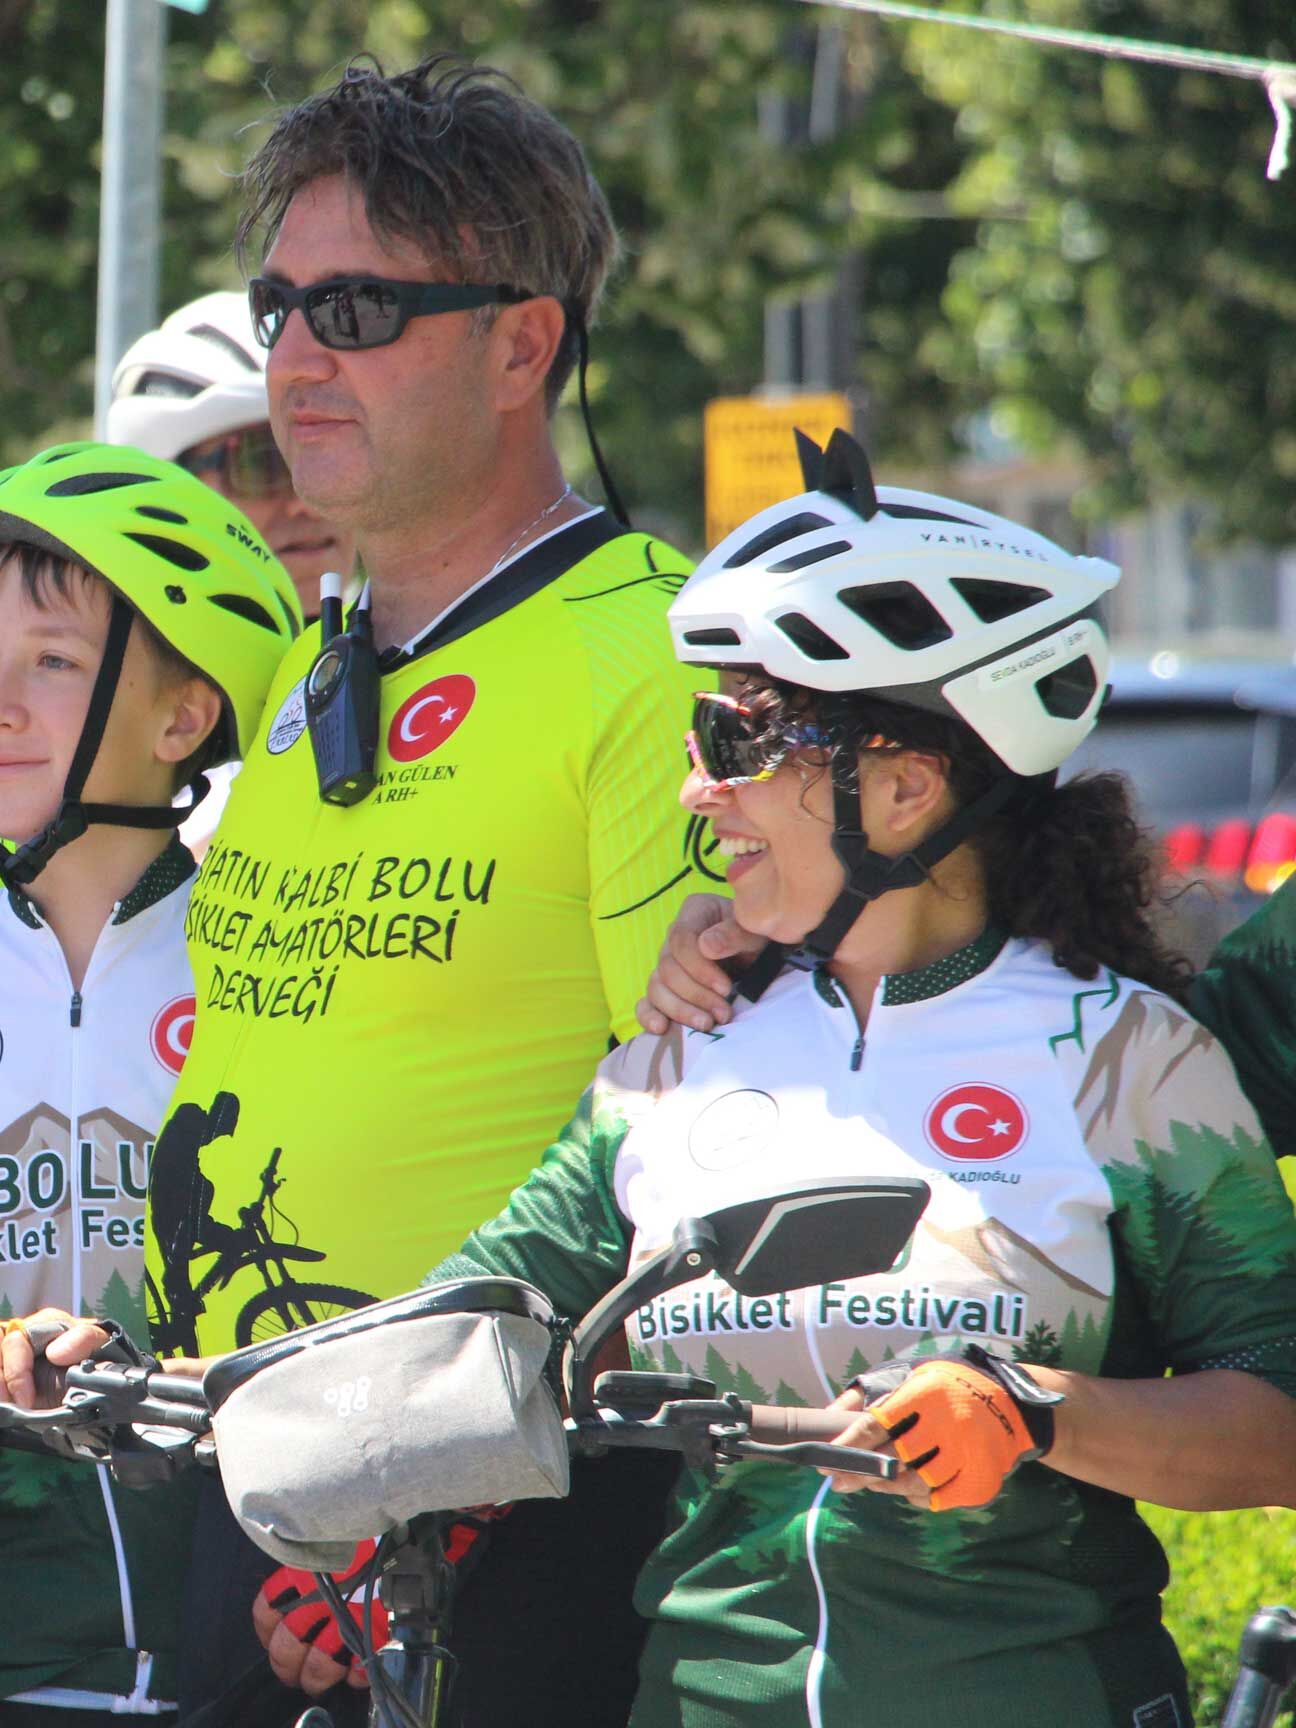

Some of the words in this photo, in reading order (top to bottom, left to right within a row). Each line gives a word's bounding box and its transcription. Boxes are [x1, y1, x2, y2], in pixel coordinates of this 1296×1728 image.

[225, 522, 271, 564] SWAY
[385, 786, 419, 803] RH+
[398, 763, 459, 784] GÜLEN
[273, 851, 365, 914] KALBİ
[367, 855, 497, 905] BOLU
[638, 1291, 793, 1340] Bisiklet
[818, 1283, 1025, 1337] Festivali
